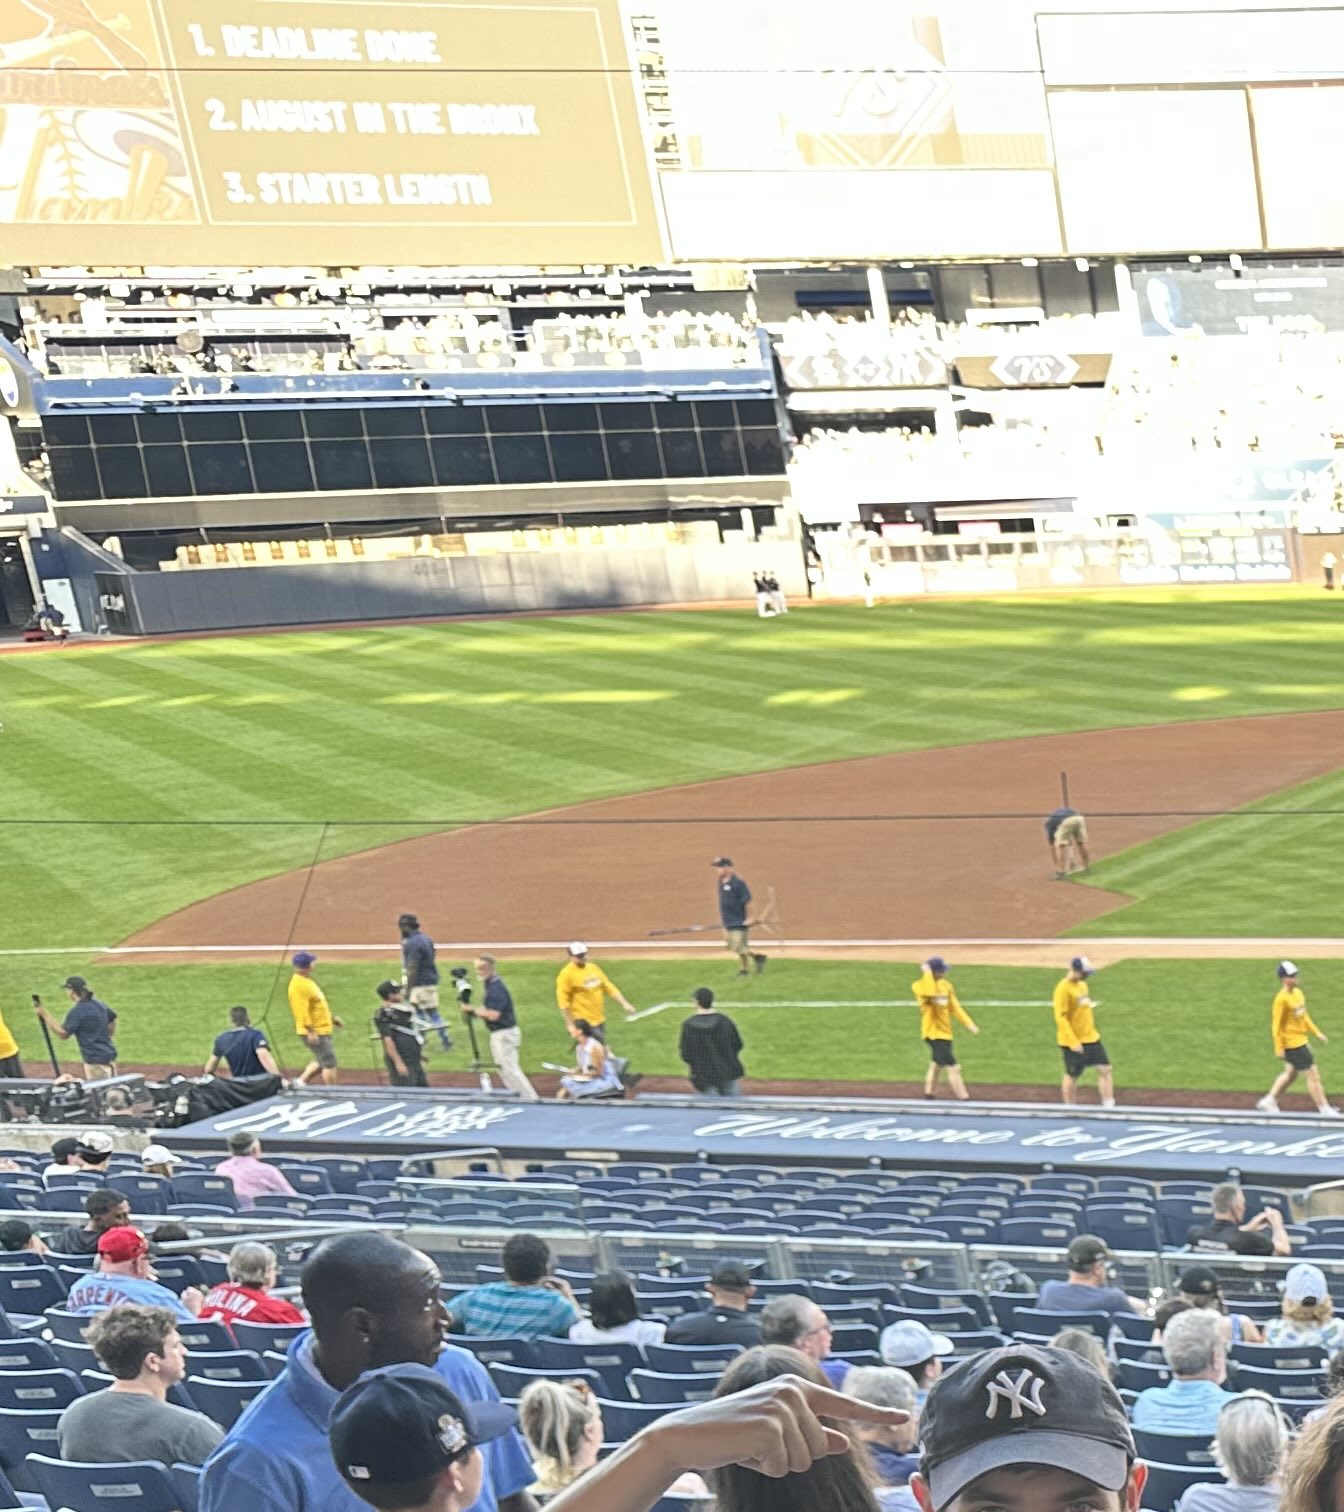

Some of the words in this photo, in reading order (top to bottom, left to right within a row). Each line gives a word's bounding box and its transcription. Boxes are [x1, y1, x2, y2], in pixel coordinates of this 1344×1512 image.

[187, 23, 215, 57] 1.
[219, 24, 362, 61] DEADLINE
[363, 30, 442, 63] DONE
[204, 97, 237, 131] 2.
[240, 99, 347, 132] AUGUST
[352, 102, 386, 133] IN
[387, 102, 446, 134] THE
[446, 104, 540, 135] BRONX
[222, 172, 255, 204] 3.
[256, 171, 383, 205] STARTER
[383, 173, 492, 206] LENGTH
[693, 1113, 1016, 1145] Welcome
[1020, 1126, 1104, 1147] to
[985, 1368, 1047, 1421] NY
